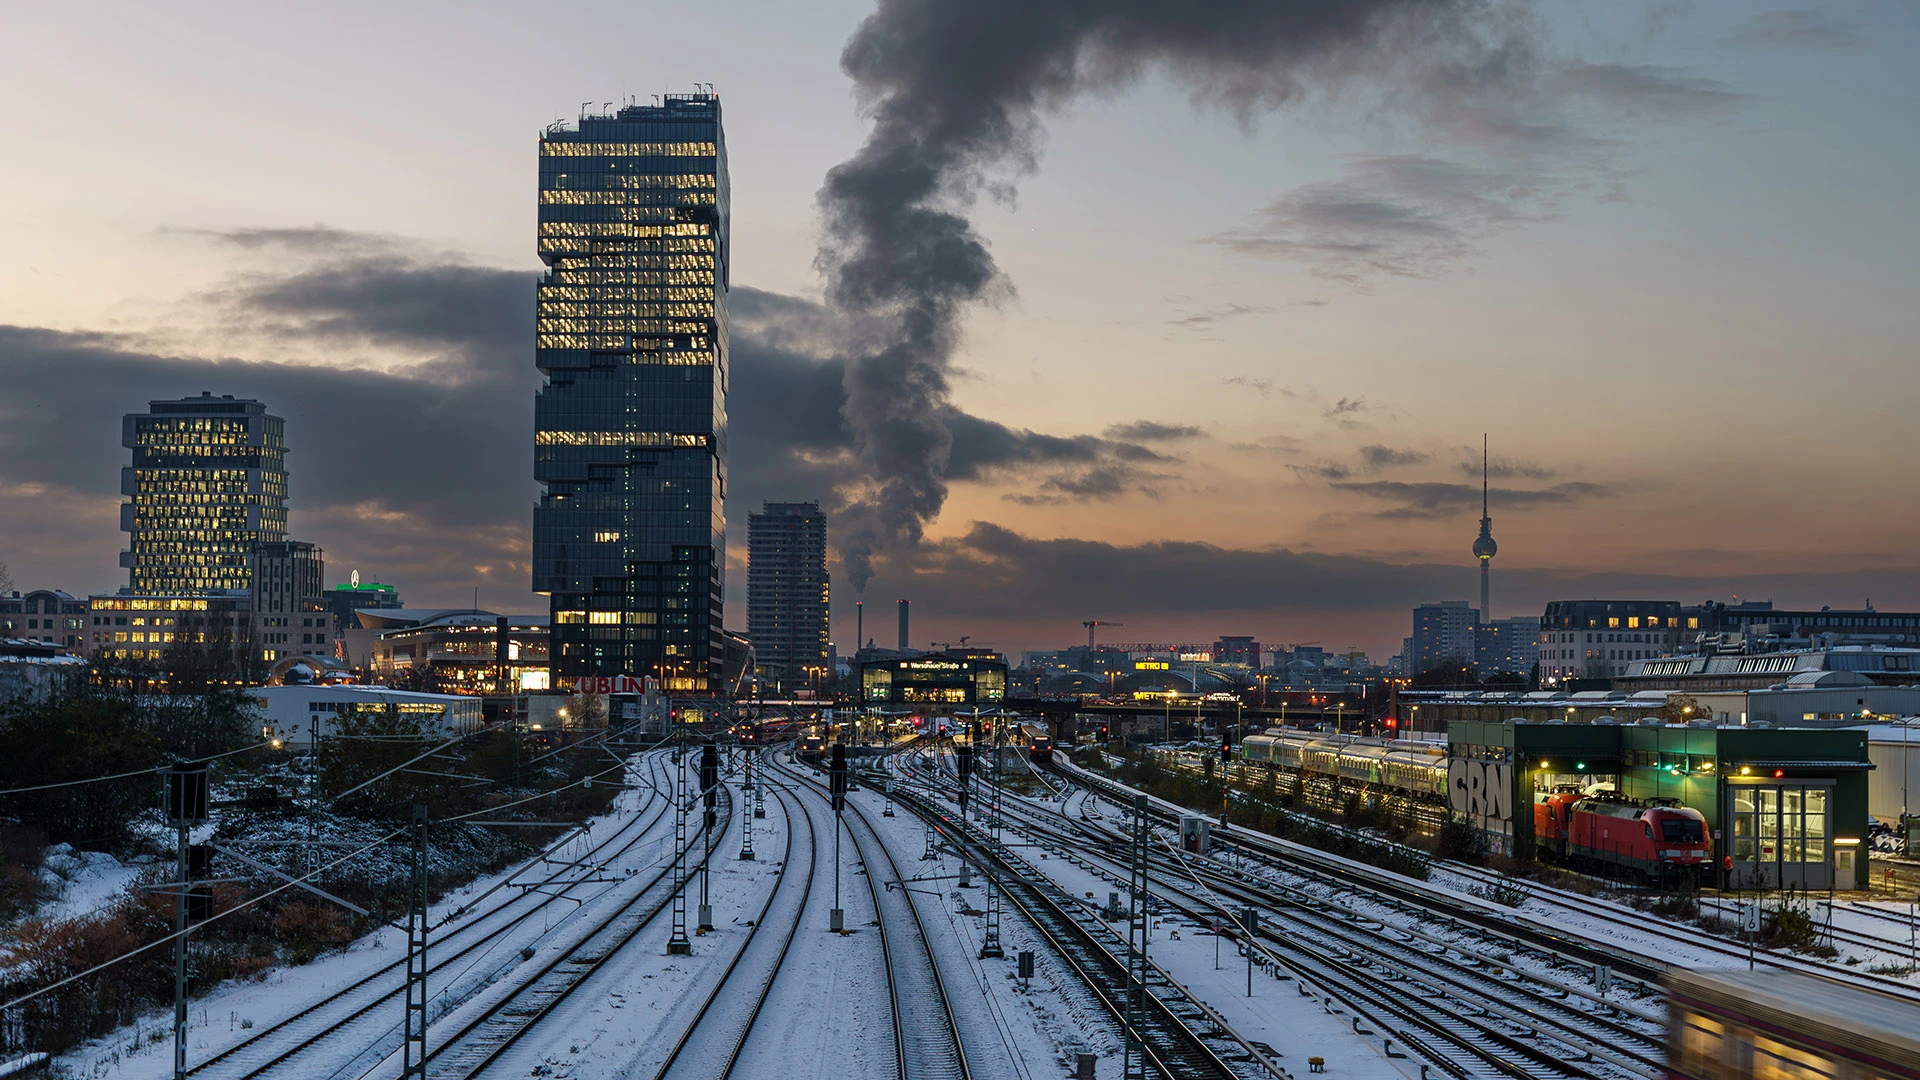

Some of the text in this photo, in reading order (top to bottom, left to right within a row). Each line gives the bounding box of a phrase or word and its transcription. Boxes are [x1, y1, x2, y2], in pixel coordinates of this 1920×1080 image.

[941, 662, 960, 670] Straße
[1135, 662, 1160, 670] METRO
[1748, 918, 1756, 929] 6
[1599, 979, 1607, 991] 6
